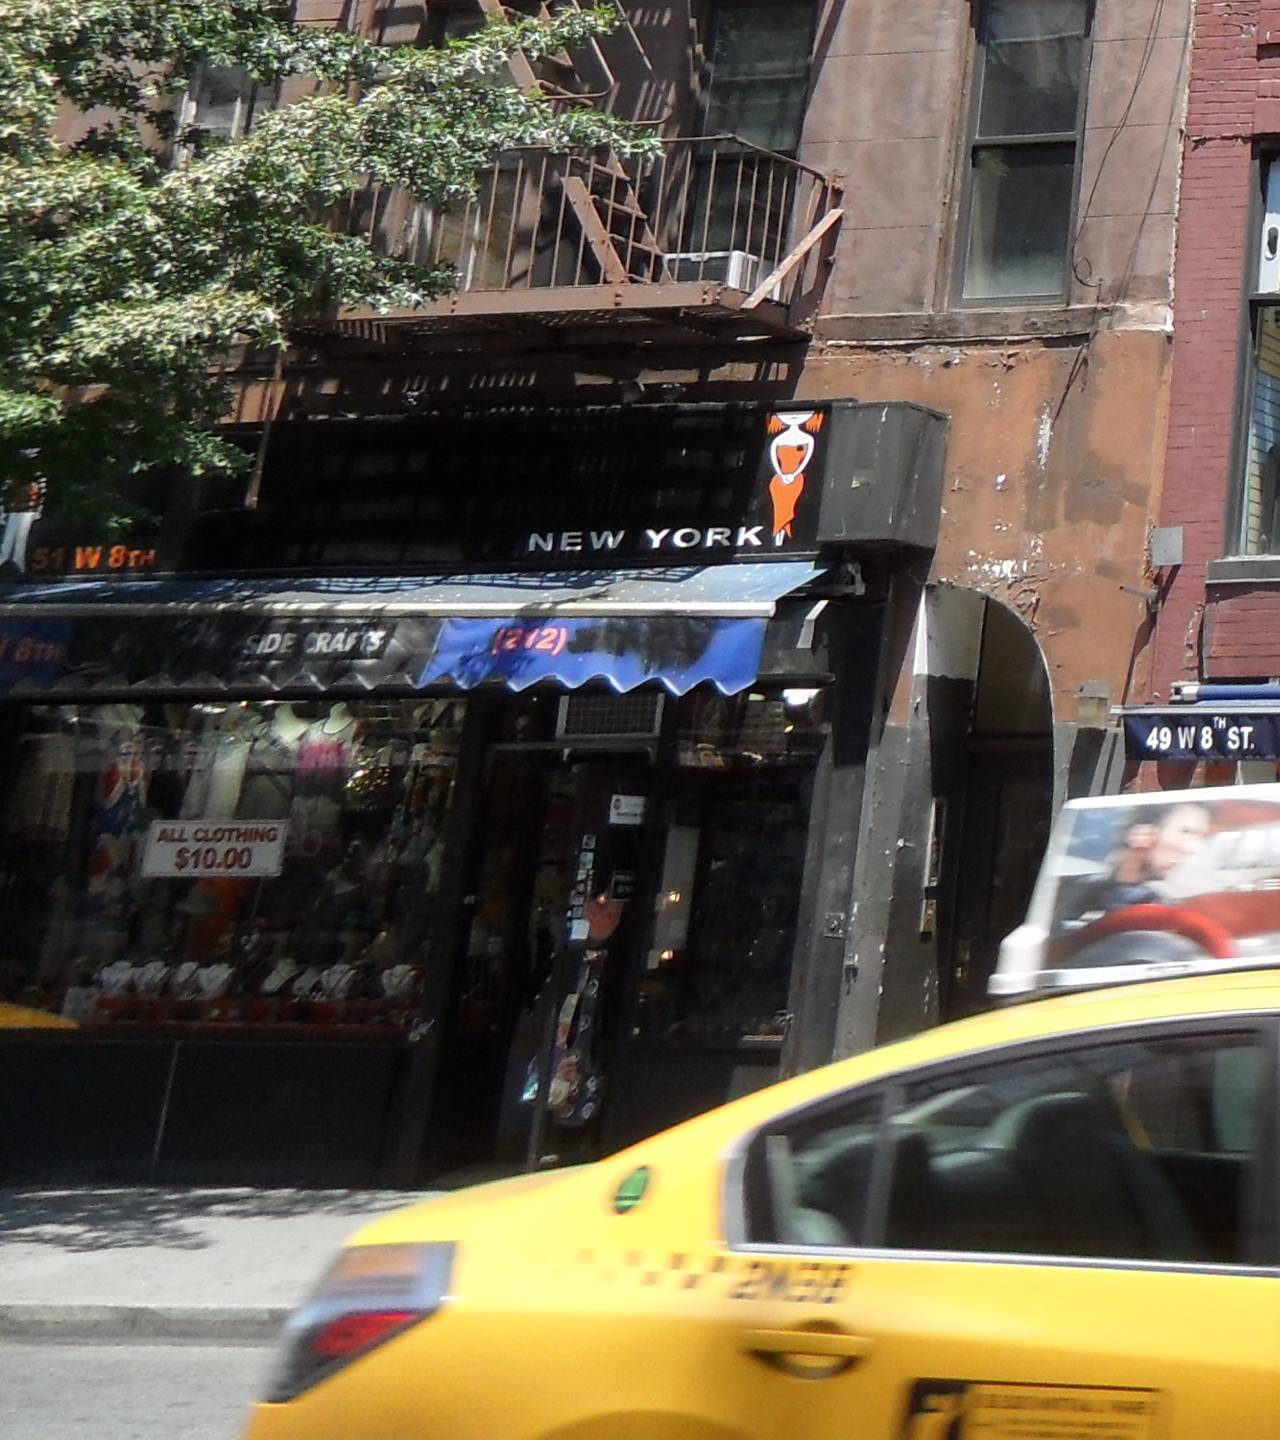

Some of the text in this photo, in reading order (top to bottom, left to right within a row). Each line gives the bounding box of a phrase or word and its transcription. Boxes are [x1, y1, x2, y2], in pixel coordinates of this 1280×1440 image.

[528, 525, 765, 552] NEW YORK
[74, 546, 102, 570] W
[108, 544, 158, 569] 8TH
[1146, 726, 1173, 750] 49
[1177, 726, 1196, 750] W
[1227, 726, 1255, 750] ST.
[157, 826, 279, 843] ALL CLOTHING
[174, 846, 253, 872] $10.00
